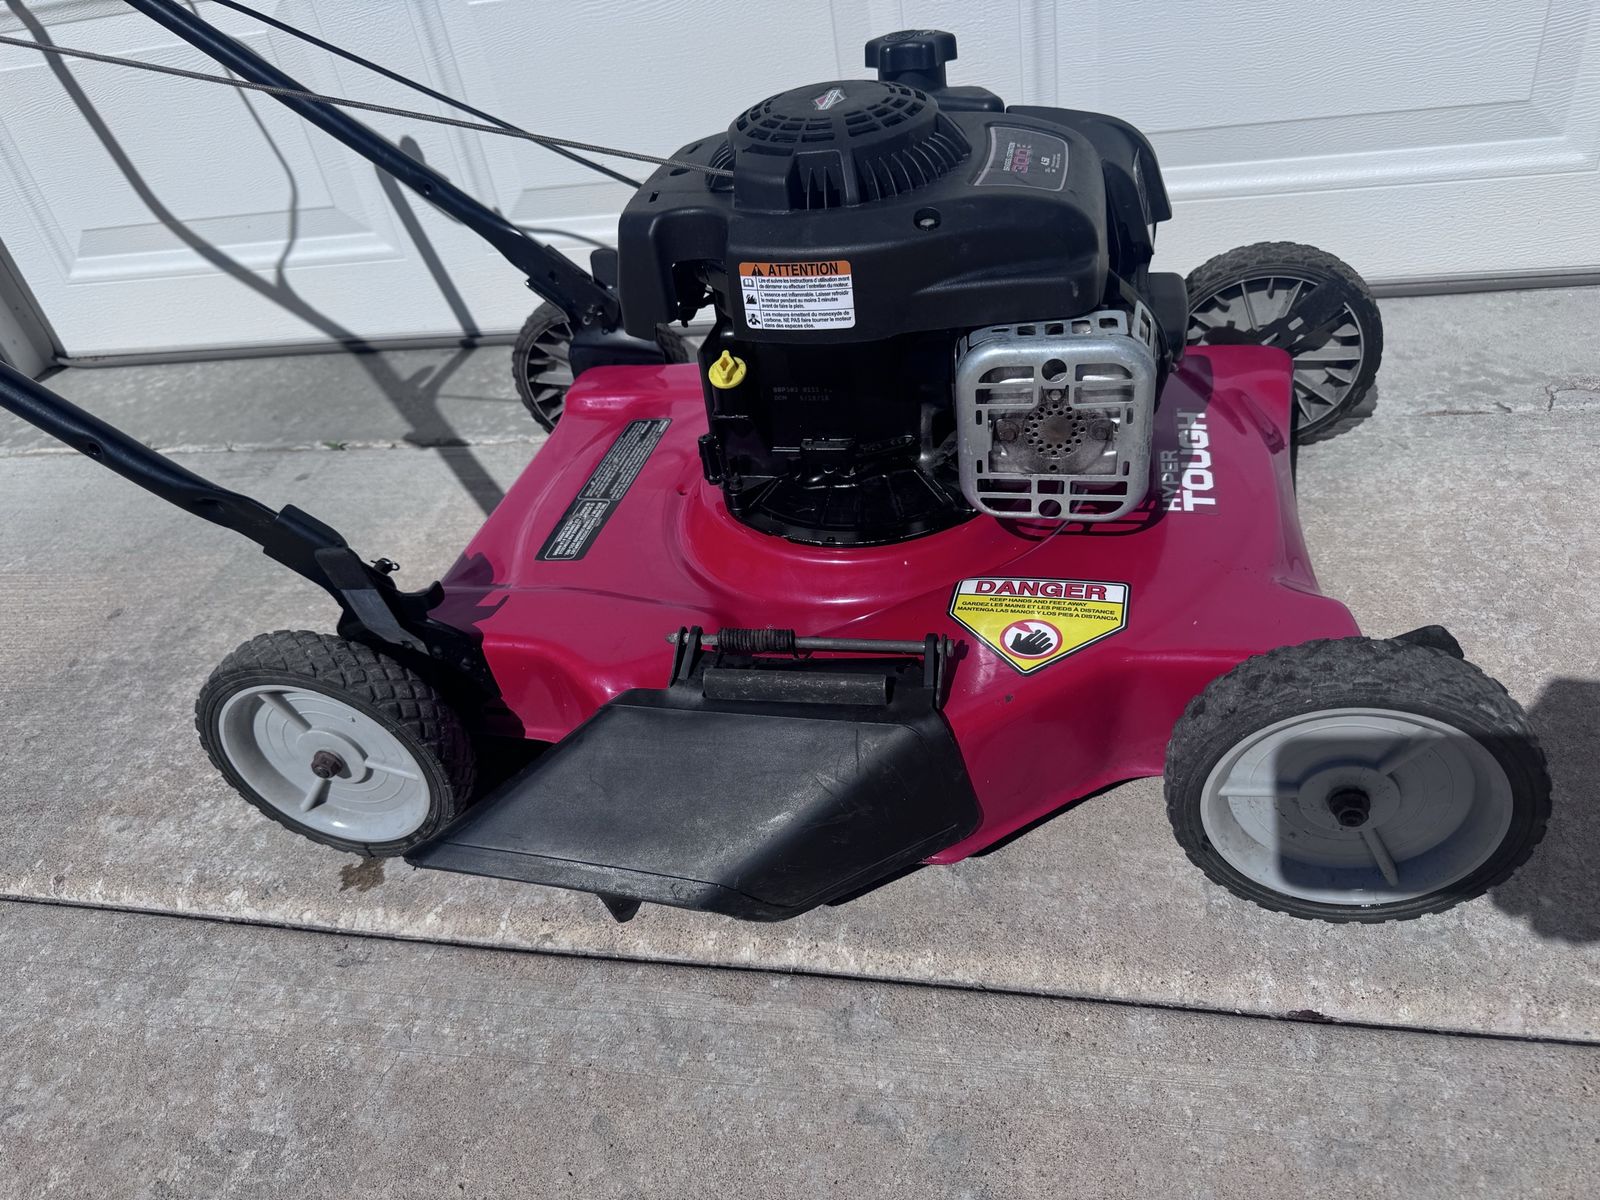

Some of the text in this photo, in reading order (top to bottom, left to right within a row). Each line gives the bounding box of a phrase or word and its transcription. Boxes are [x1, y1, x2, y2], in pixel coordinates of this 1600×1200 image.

[768, 262, 839, 277] ATTENTION
[1177, 412, 1216, 511] TOUGH
[1161, 450, 1182, 511] HYPER
[975, 580, 1108, 601] DANGER
[1080, 614, 1119, 622] DISTANCIA
